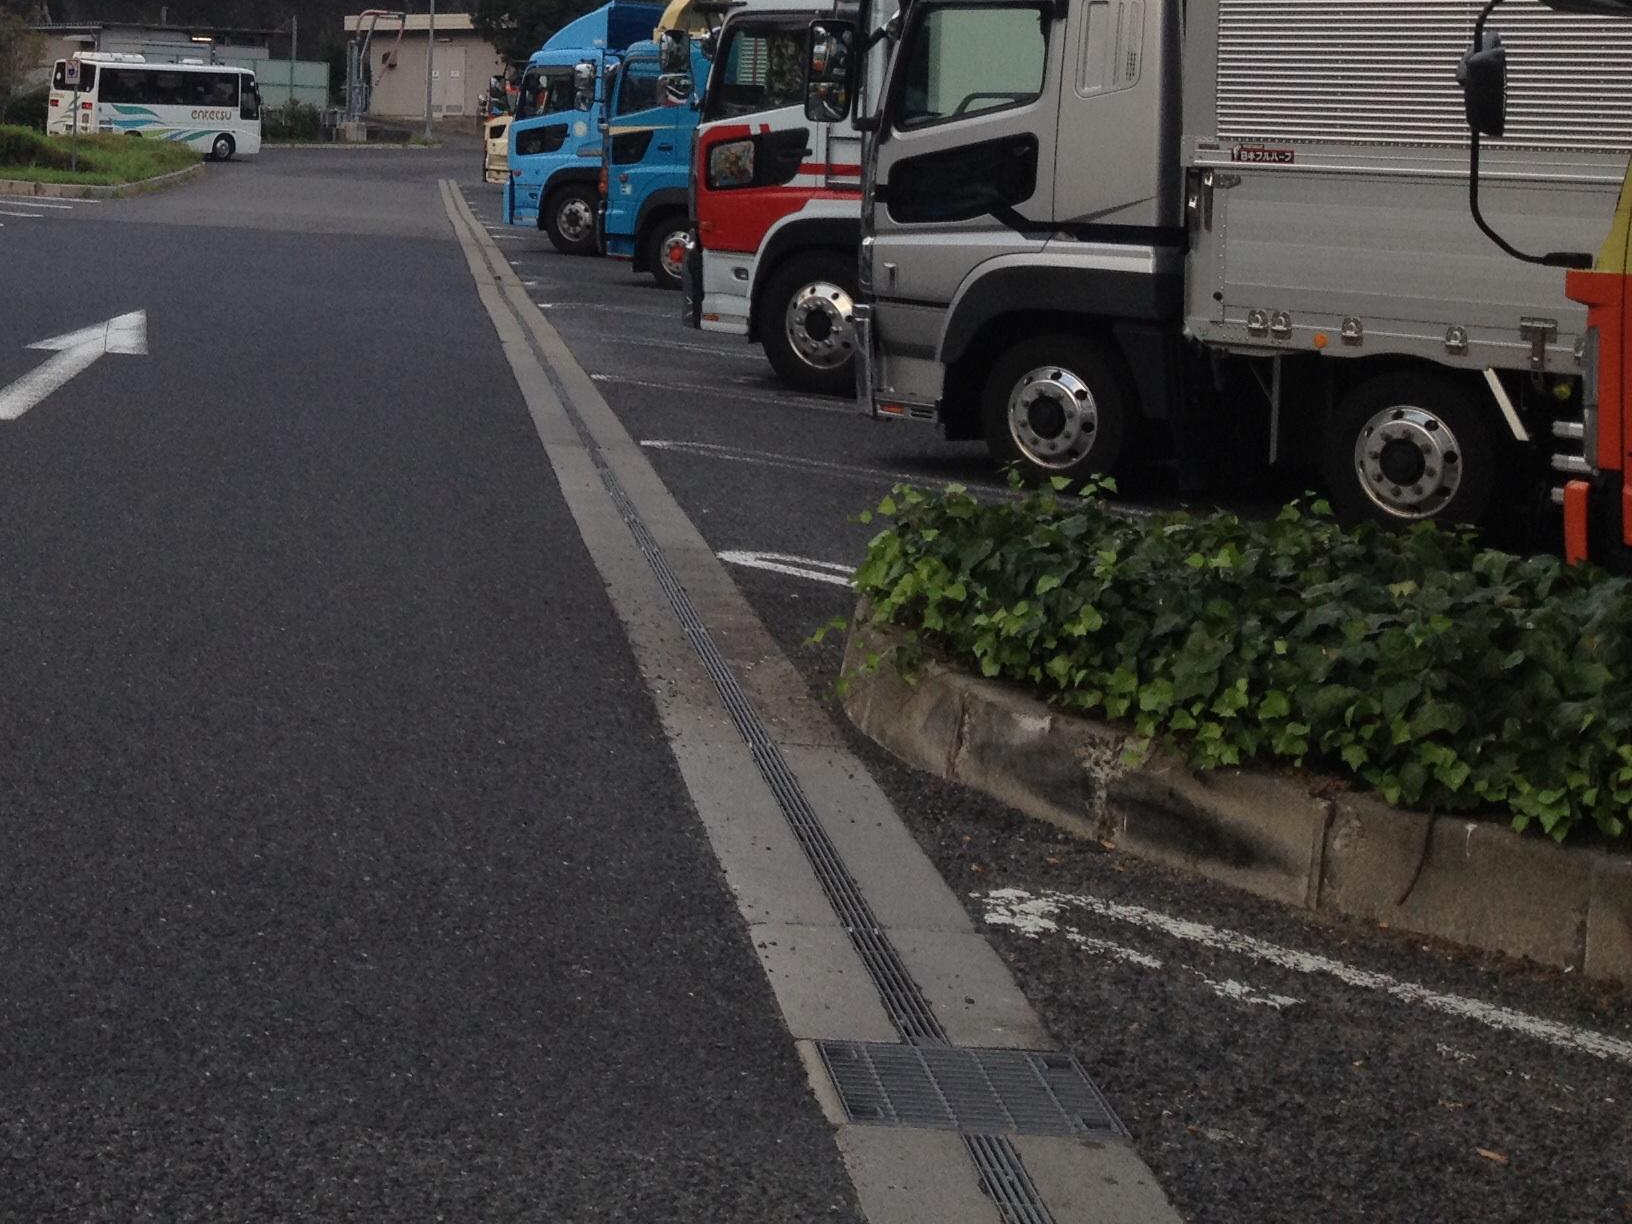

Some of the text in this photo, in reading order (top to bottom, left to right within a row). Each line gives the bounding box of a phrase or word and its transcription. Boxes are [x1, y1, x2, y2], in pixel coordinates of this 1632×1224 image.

[1240, 151, 1292, 162] 日本フルハーフ
